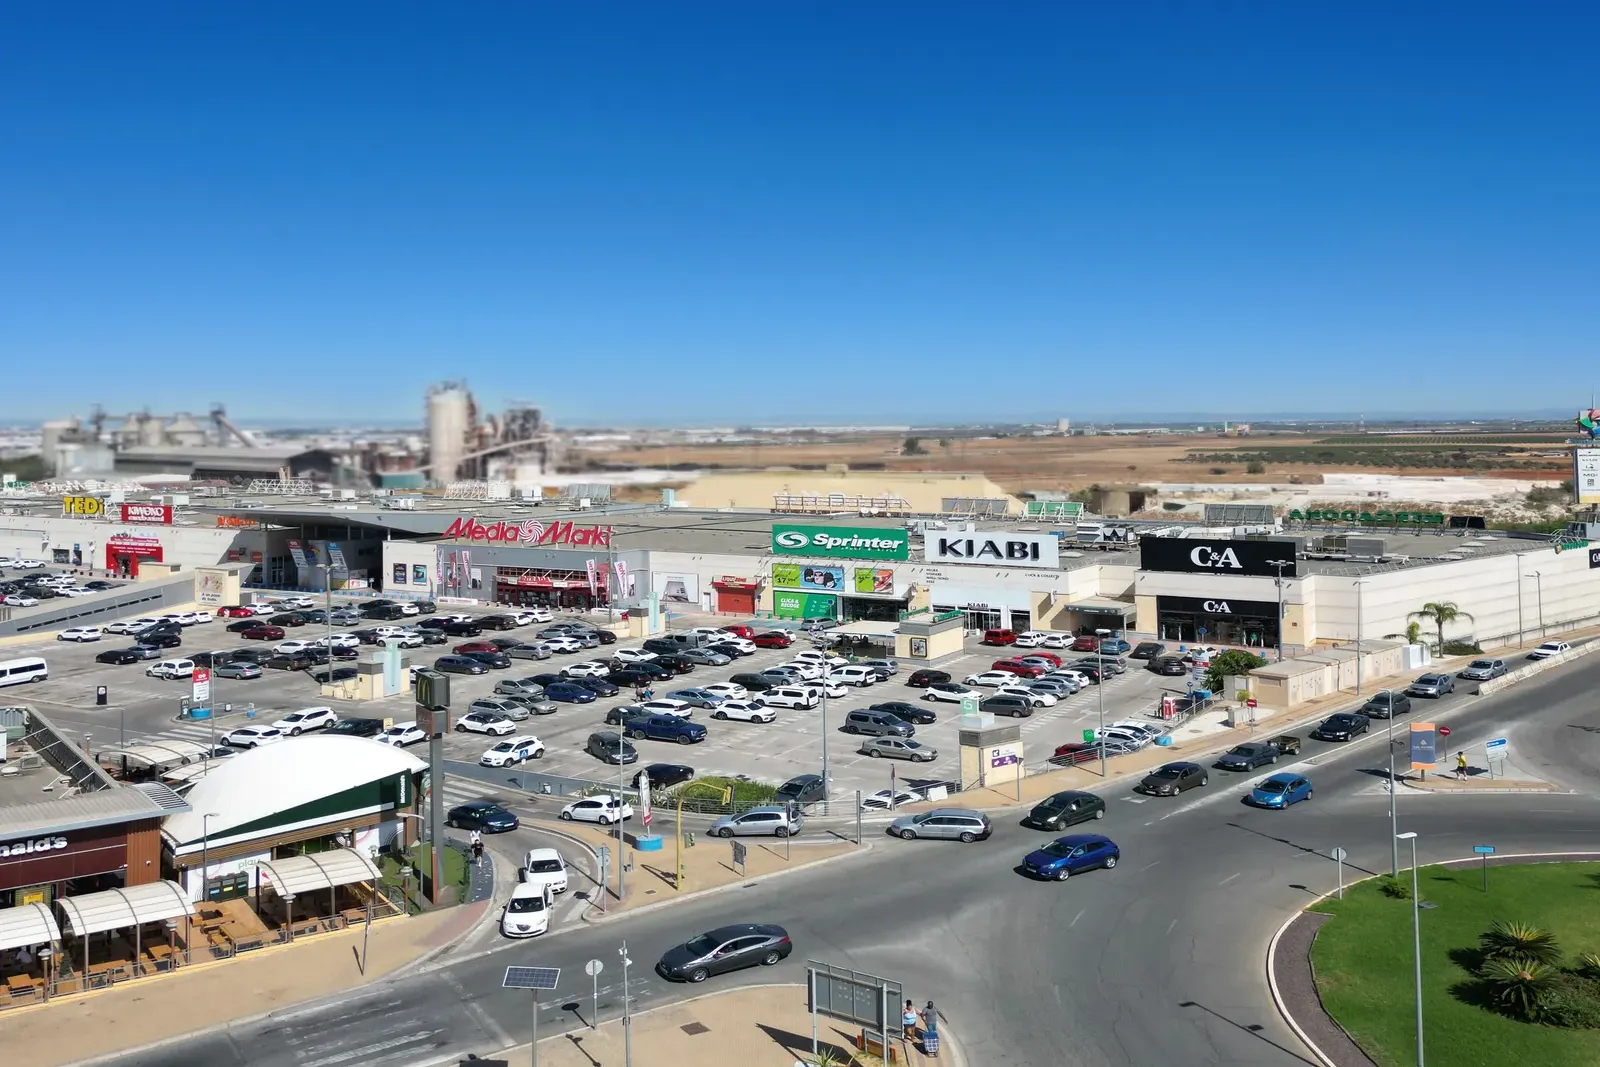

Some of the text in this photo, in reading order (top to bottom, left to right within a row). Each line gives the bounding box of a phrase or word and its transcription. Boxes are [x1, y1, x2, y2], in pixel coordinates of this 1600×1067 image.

[63, 496, 105, 515] TEDi
[442, 517, 614, 545] Media Markt
[813, 533, 903, 550] Sprinter
[938, 538, 1040, 561] KIABI
[1190, 546, 1243, 569] C&A
[1203, 600, 1231, 613] C&A
